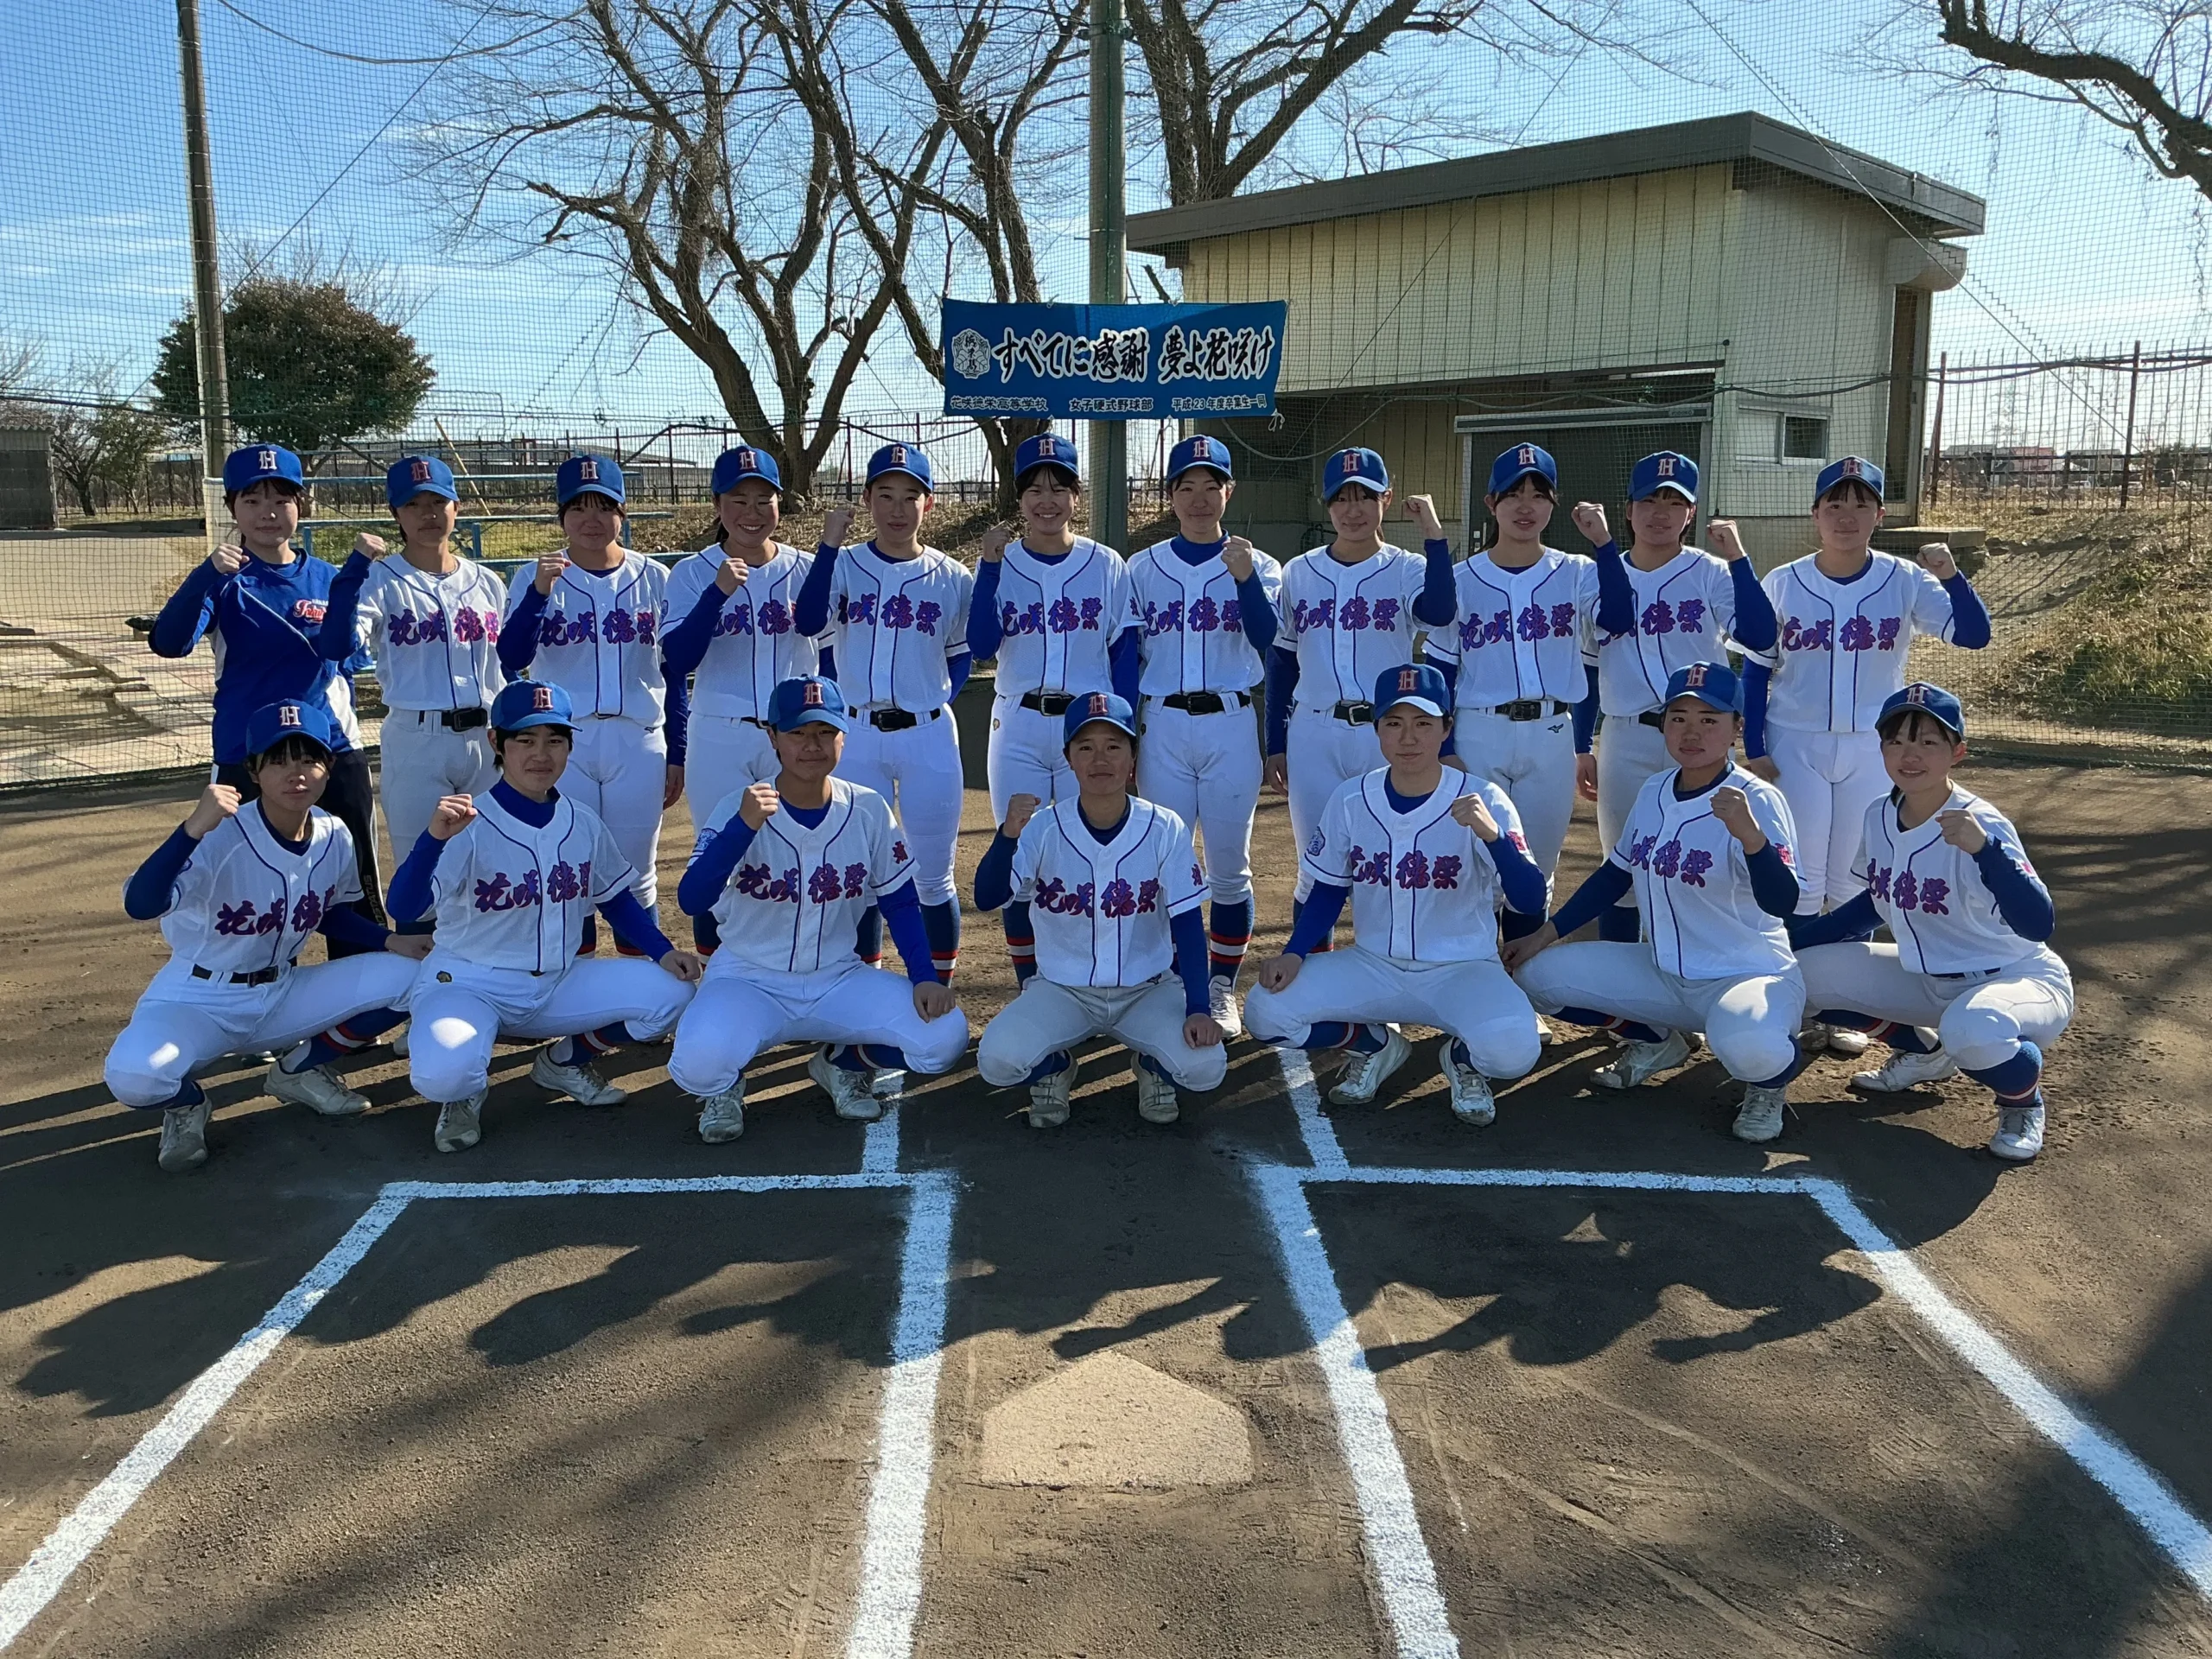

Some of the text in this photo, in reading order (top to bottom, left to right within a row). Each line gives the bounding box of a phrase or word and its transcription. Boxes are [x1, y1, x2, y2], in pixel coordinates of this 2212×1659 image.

[991, 325, 1275, 385] すべてに感謝 夢よ花咲け
[950, 395, 1048, 411] 花咲徳栄高等学校
[1069, 397, 1154, 412] 女子硬式野球部
[891, 445, 907, 465] H
[1039, 437, 1056, 456] H
[1192, 439, 1210, 459] H
[1517, 447, 1535, 466] H
[258, 450, 277, 470] H
[739, 449, 758, 470] H
[1343, 452, 1360, 474] H
[1657, 457, 1675, 477] H
[1841, 458, 1862, 475] H
[411, 461, 431, 481] H
[580, 461, 599, 480] H
[713, 599, 797, 638] 咲徳
[1458, 601, 1576, 652] 花咲徳栄
[1397, 669, 1419, 692] H
[1686, 665, 1707, 688] H
[532, 687, 553, 710] H
[804, 682, 823, 705] H
[1906, 685, 1929, 705] H
[1088, 694, 1109, 715] H
[278, 705, 302, 727] H
[1630, 829, 1713, 888] 咲徳栄
[736, 862, 868, 904] 花咲徳栄
[1034, 877, 1160, 918] 花咲徳栄
